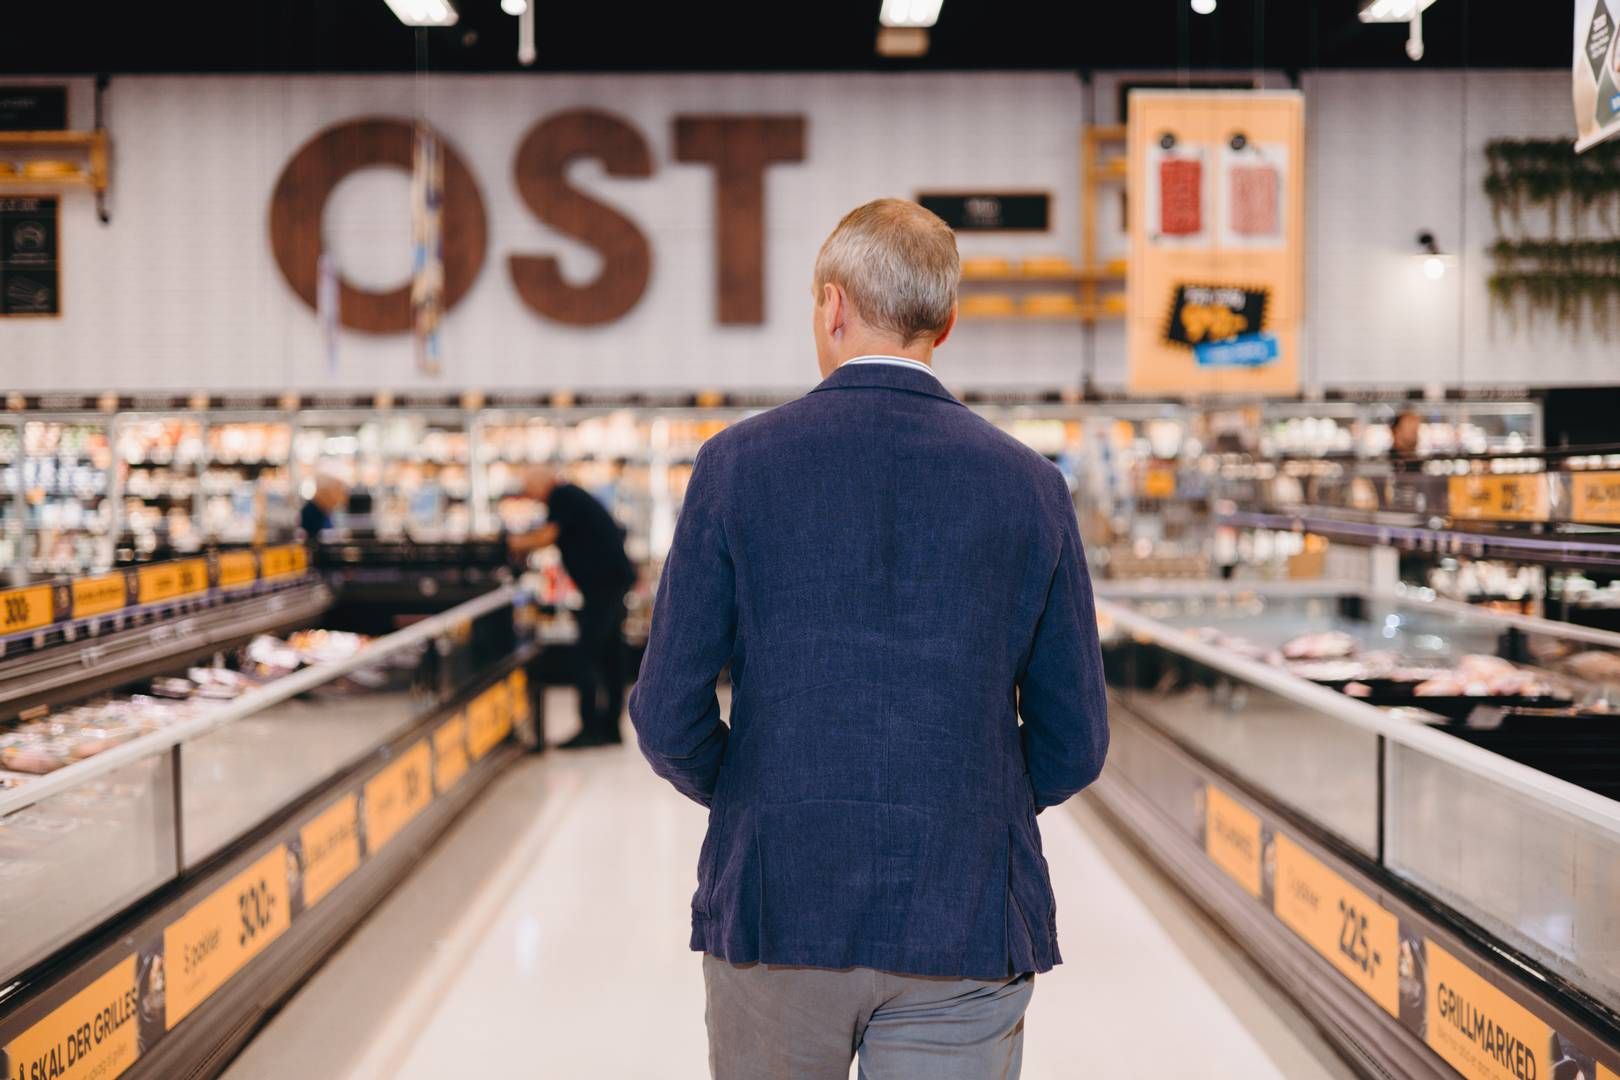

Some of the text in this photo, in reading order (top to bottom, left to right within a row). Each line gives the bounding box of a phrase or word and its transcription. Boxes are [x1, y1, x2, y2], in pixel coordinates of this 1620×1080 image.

[269, 108, 808, 336] OST
[31, 1043, 65, 1080] SKAL
[67, 1022, 91, 1068] DER
[1437, 981, 1537, 1080] GRILLMARKED
